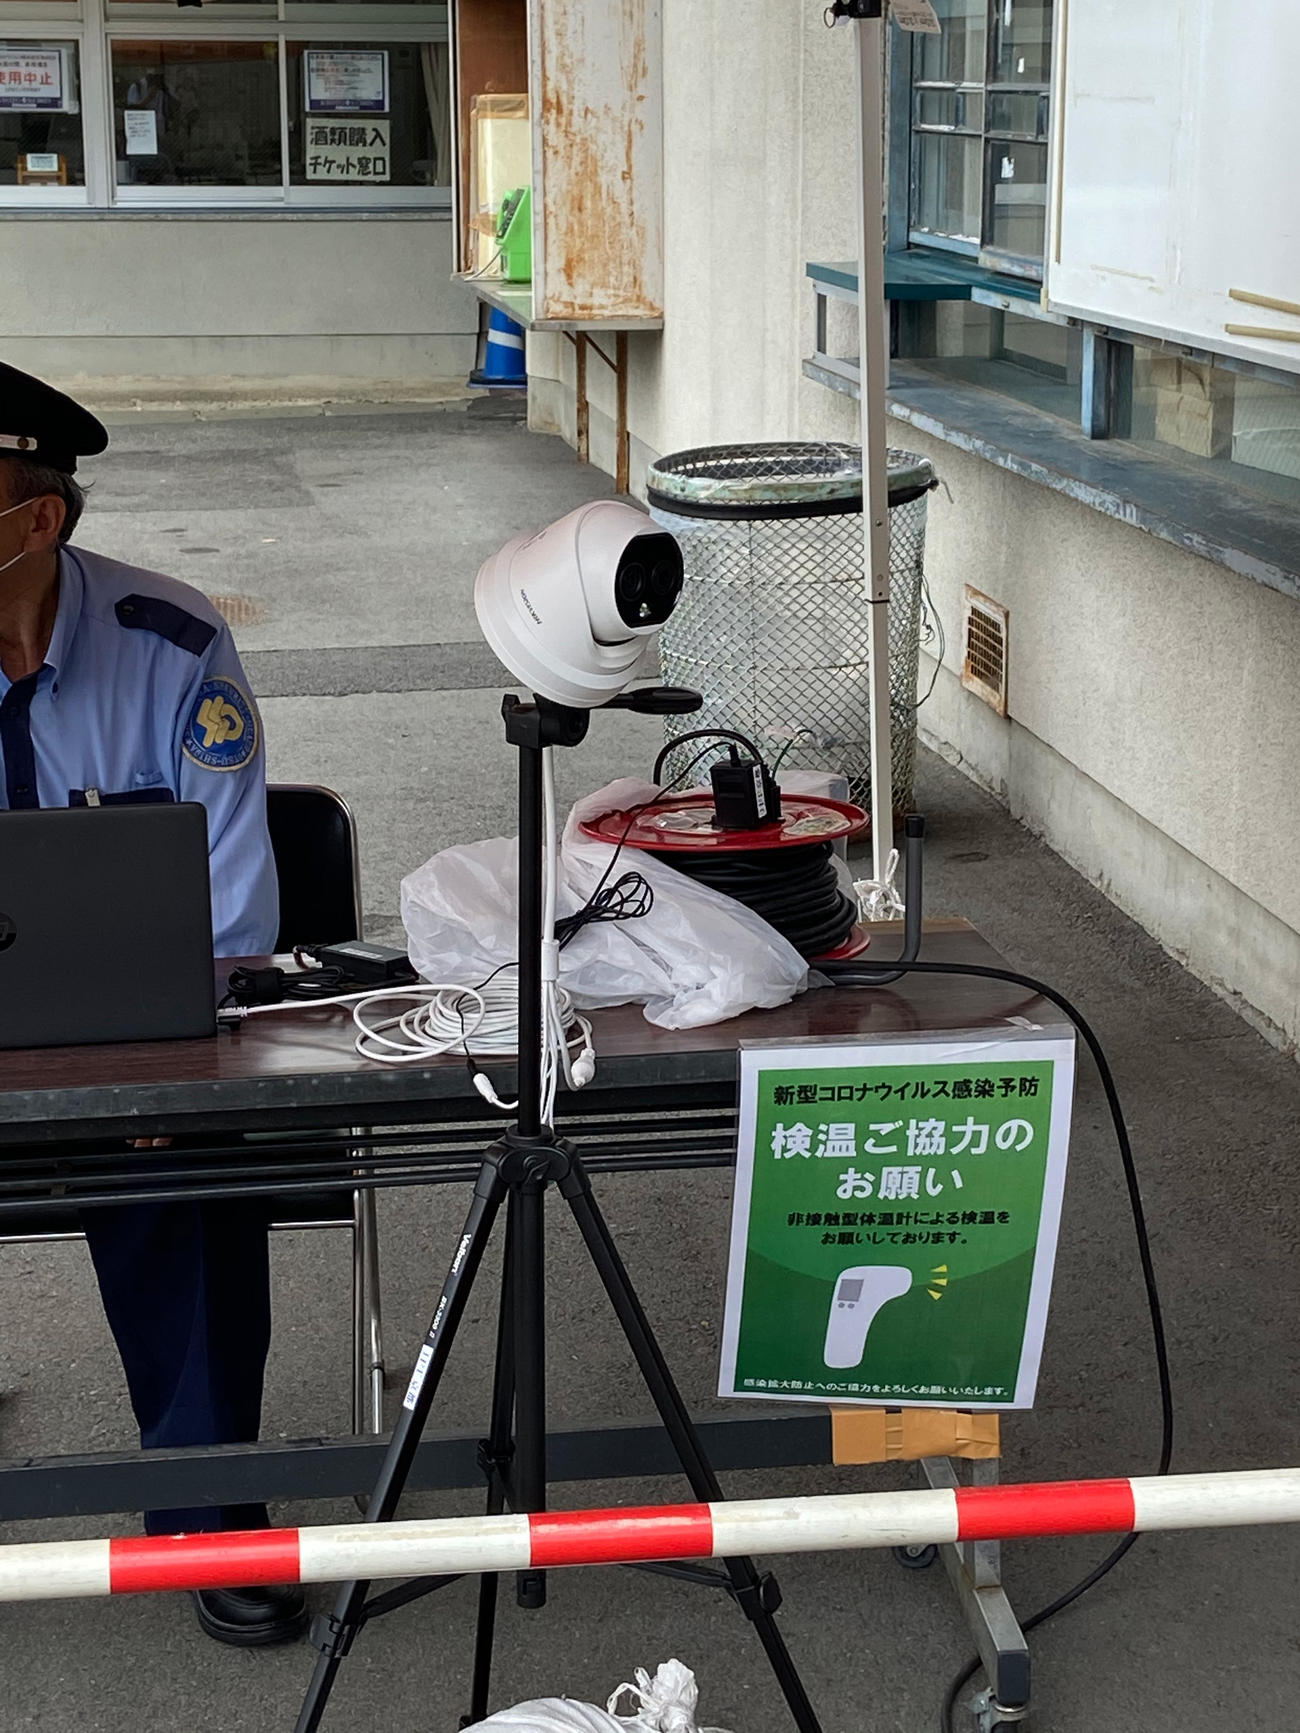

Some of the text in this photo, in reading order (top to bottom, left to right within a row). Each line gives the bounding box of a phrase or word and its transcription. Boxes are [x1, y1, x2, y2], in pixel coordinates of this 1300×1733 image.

[310, 126, 386, 147] 酒類購入
[309, 155, 386, 176] チケット窓口
[773, 1076, 1040, 1105] 新型コロナウイルス感染予防
[770, 1116, 1035, 1159] 検温ご協力の
[836, 1165, 964, 1200] お願い
[787, 1210, 1010, 1227] 非接触型体温計による検温を
[821, 1231, 968, 1246] お願いしております。
[451, 1233, 471, 1274] Velbon
[743, 1378, 1009, 1397] 感染拡大防止へのご協力をよろしくお願いいたします。
